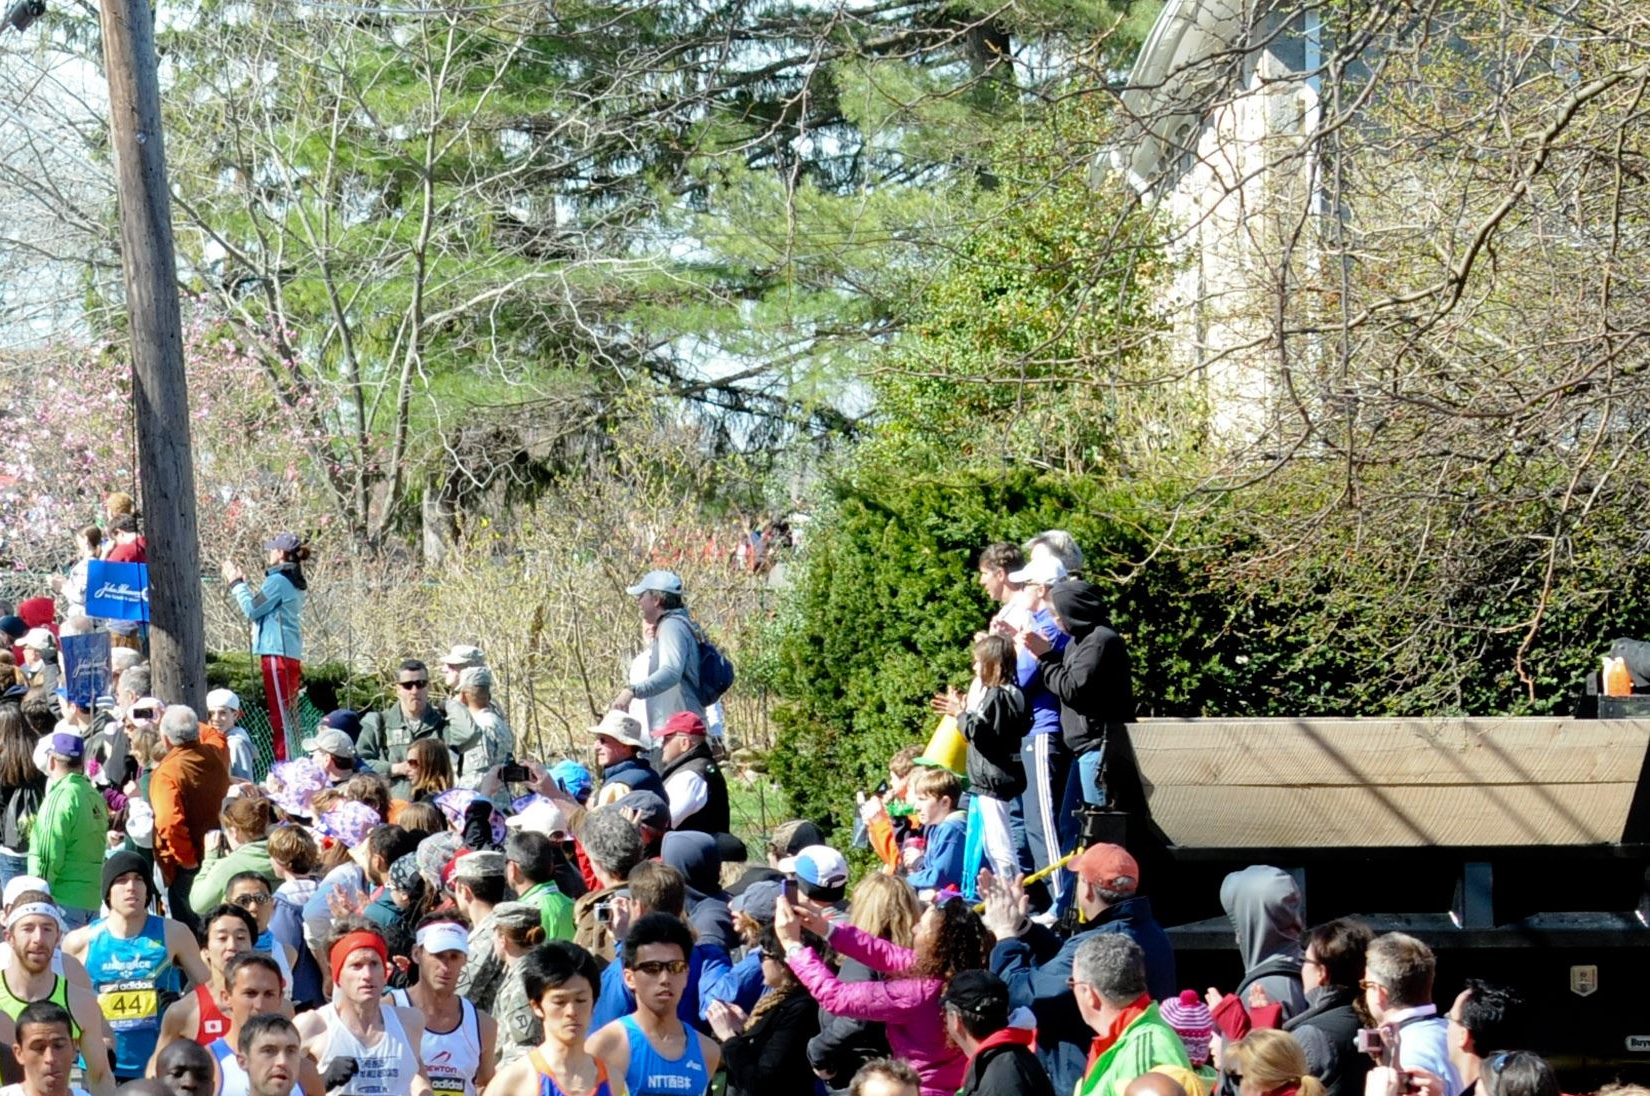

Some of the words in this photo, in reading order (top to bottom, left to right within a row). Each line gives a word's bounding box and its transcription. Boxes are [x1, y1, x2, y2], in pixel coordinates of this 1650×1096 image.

[119, 981, 154, 991] adidas
[112, 994, 143, 1015] 44
[432, 1077, 463, 1088] adidas
